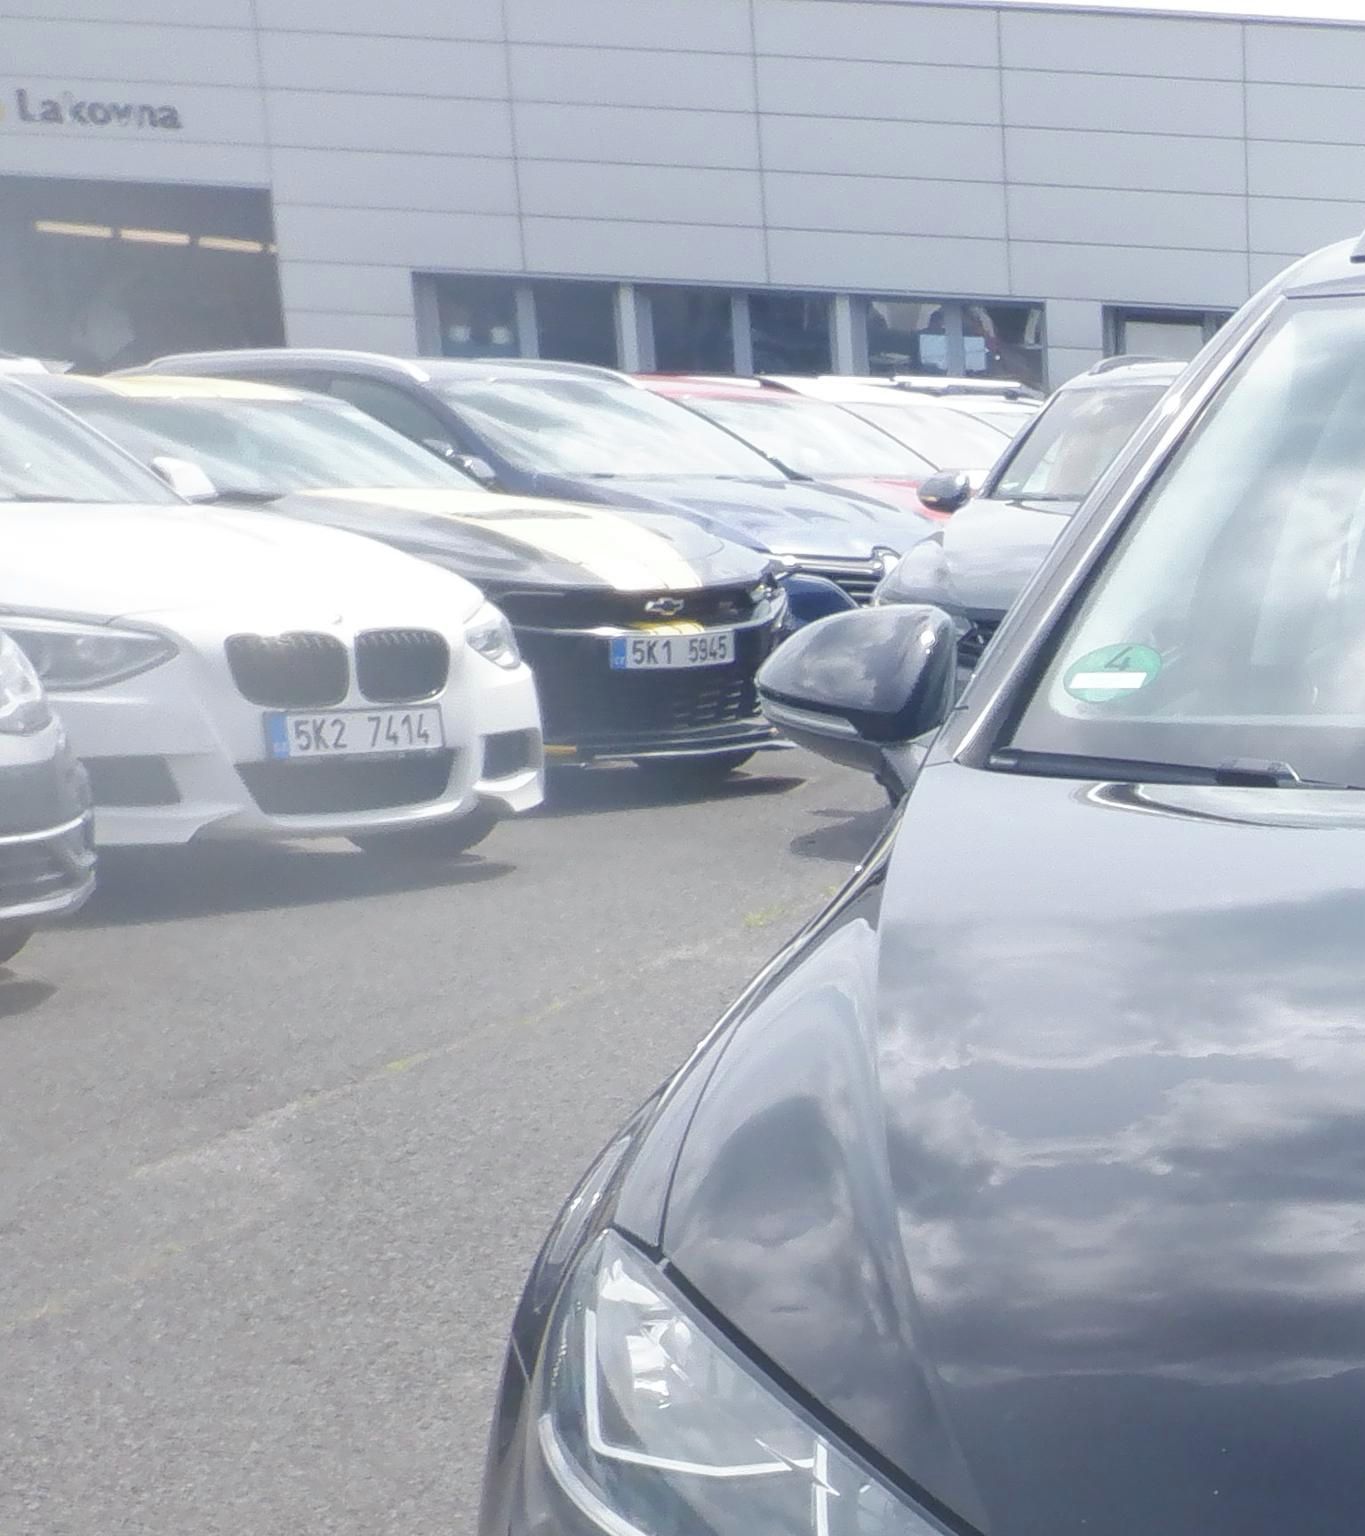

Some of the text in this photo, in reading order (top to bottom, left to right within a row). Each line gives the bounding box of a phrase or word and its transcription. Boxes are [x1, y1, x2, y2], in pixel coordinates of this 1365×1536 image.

[632, 635, 727, 665] 5K1 5945
[1103, 646, 1133, 671] 4
[294, 713, 430, 751] 5K2 7414
